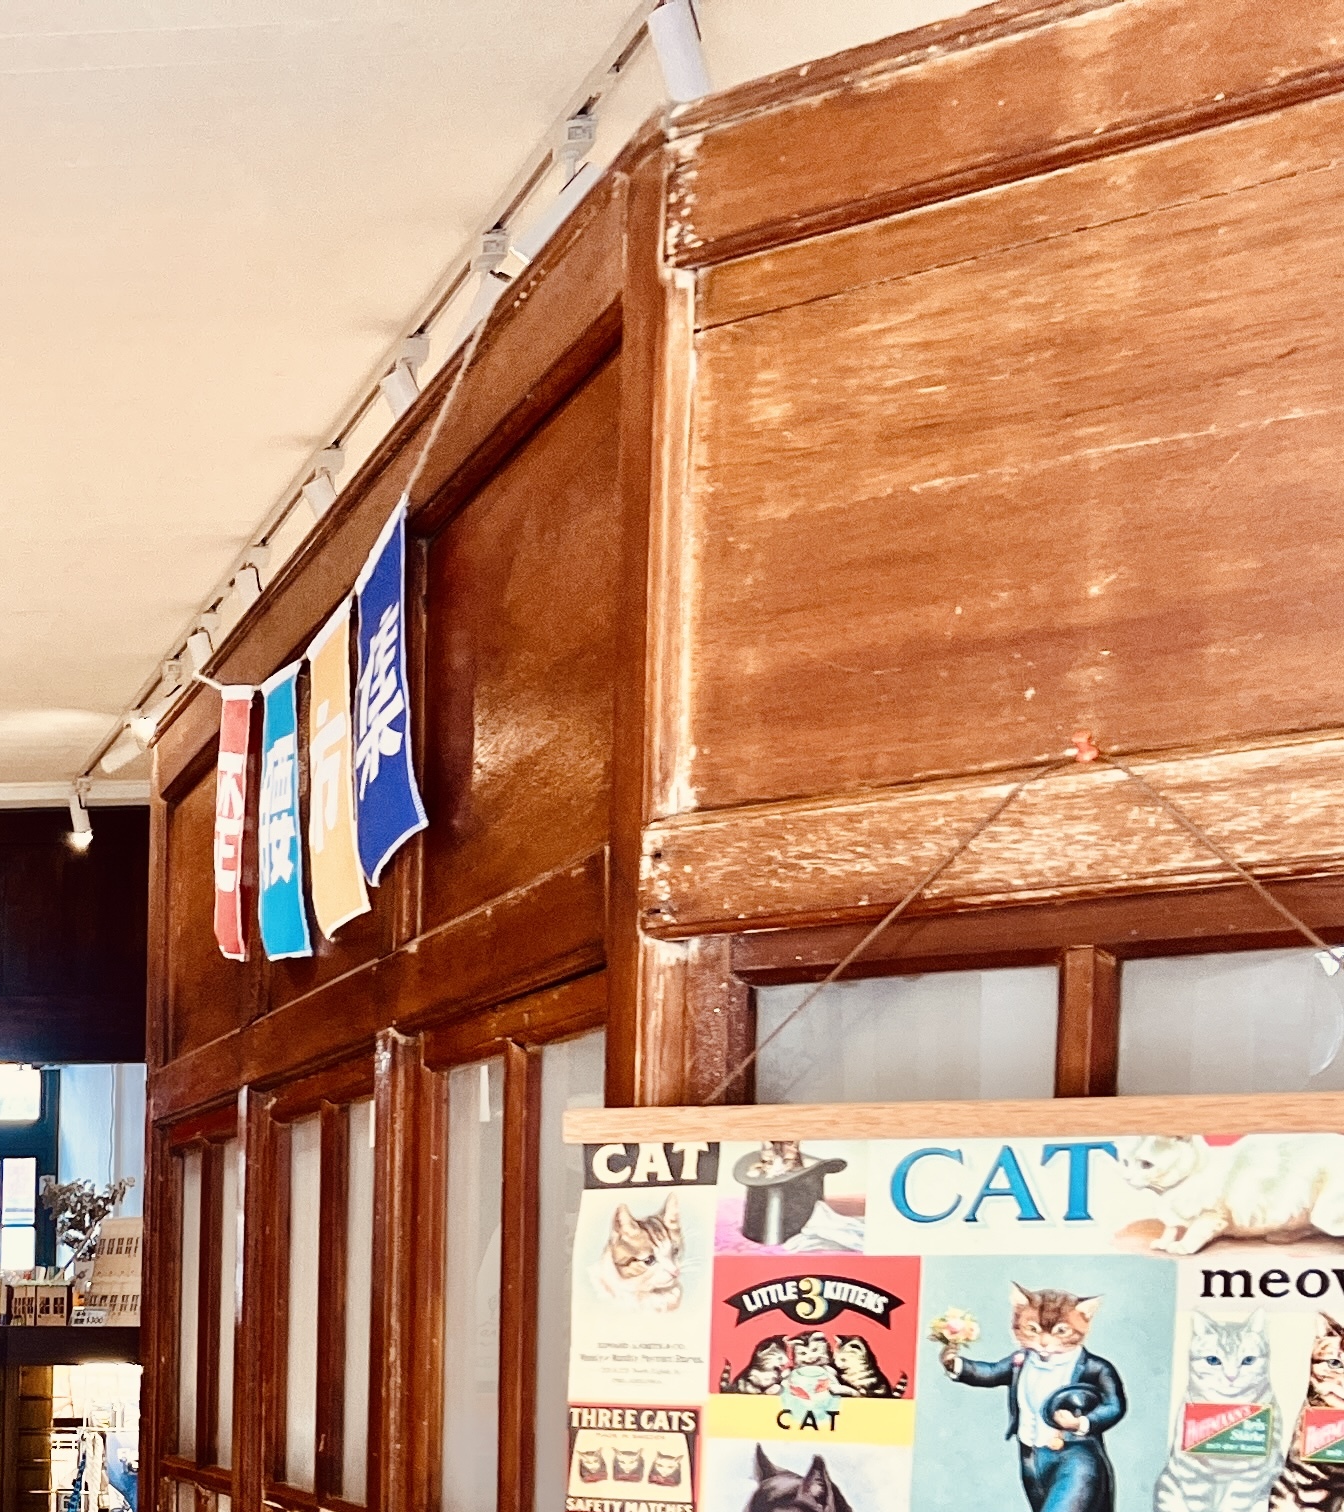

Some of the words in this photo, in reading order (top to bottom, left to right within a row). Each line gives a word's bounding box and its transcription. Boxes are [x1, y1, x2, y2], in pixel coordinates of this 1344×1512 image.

[591, 1142, 710, 1184] CAT
[890, 1140, 1120, 1225] CAT
[742, 1281, 798, 1314] LITTLE
[795, 1277, 827, 1320] 3
[823, 1281, 890, 1315] KITTENS
[570, 1408, 637, 1430] THREE
[640, 1411, 697, 1432] CATS
[776, 1410, 841, 1432] CAT
